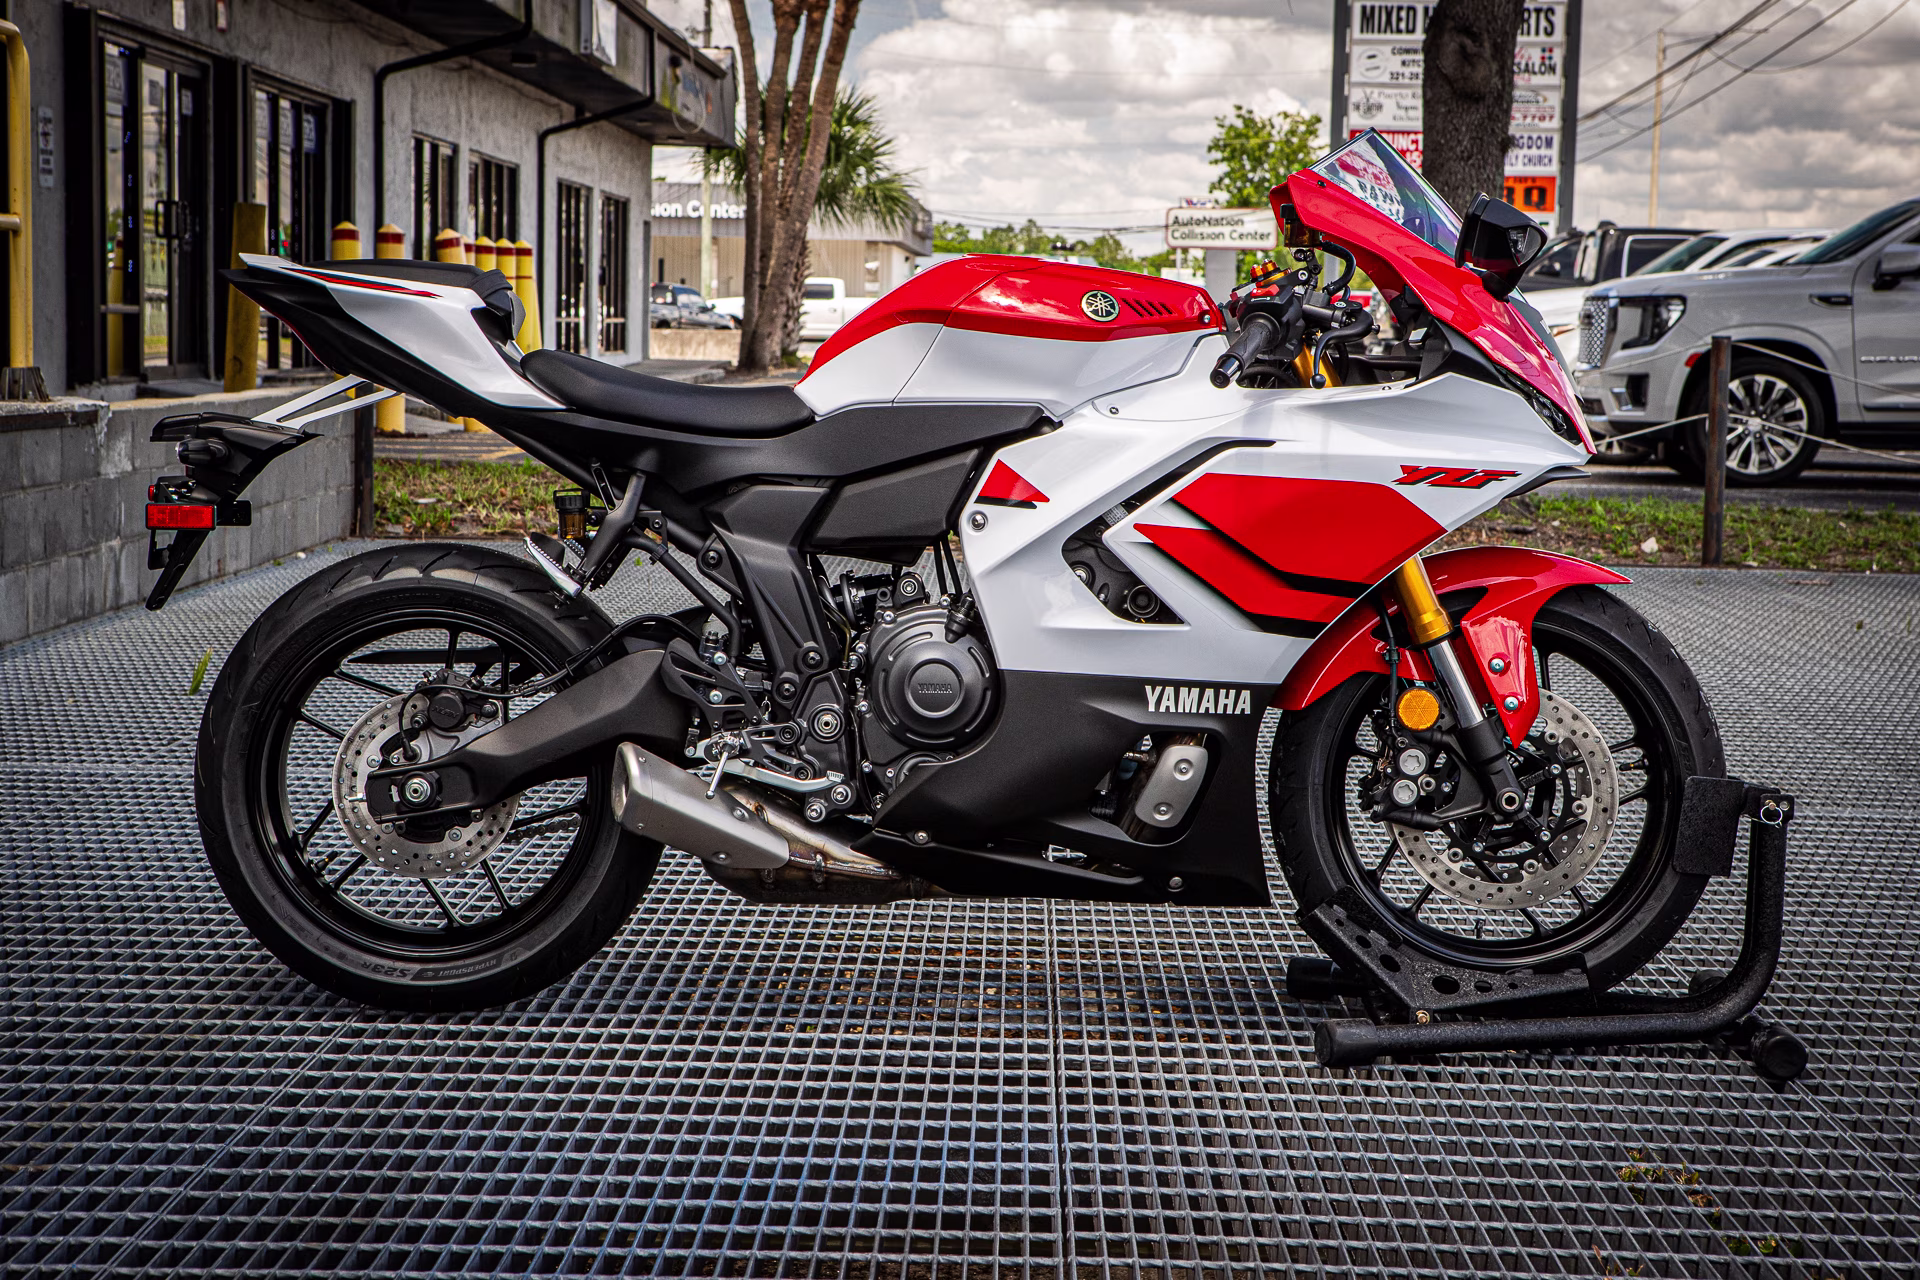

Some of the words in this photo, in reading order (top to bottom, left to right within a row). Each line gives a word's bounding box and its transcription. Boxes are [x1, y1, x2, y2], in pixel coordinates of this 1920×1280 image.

[1360, 4, 1417, 34] MIXED
[1521, 7, 1555, 37] RTS
[1522, 154, 1552, 167] CHURCH
[1172, 215, 1245, 226] AutoNation
[1171, 229, 1225, 240] Collision
[1229, 229, 1271, 240] Center
[918, 683, 953, 693] YAMAHA
[1145, 685, 1251, 714] YAMAHA
[437, 959, 497, 977] HYPERSPORT
